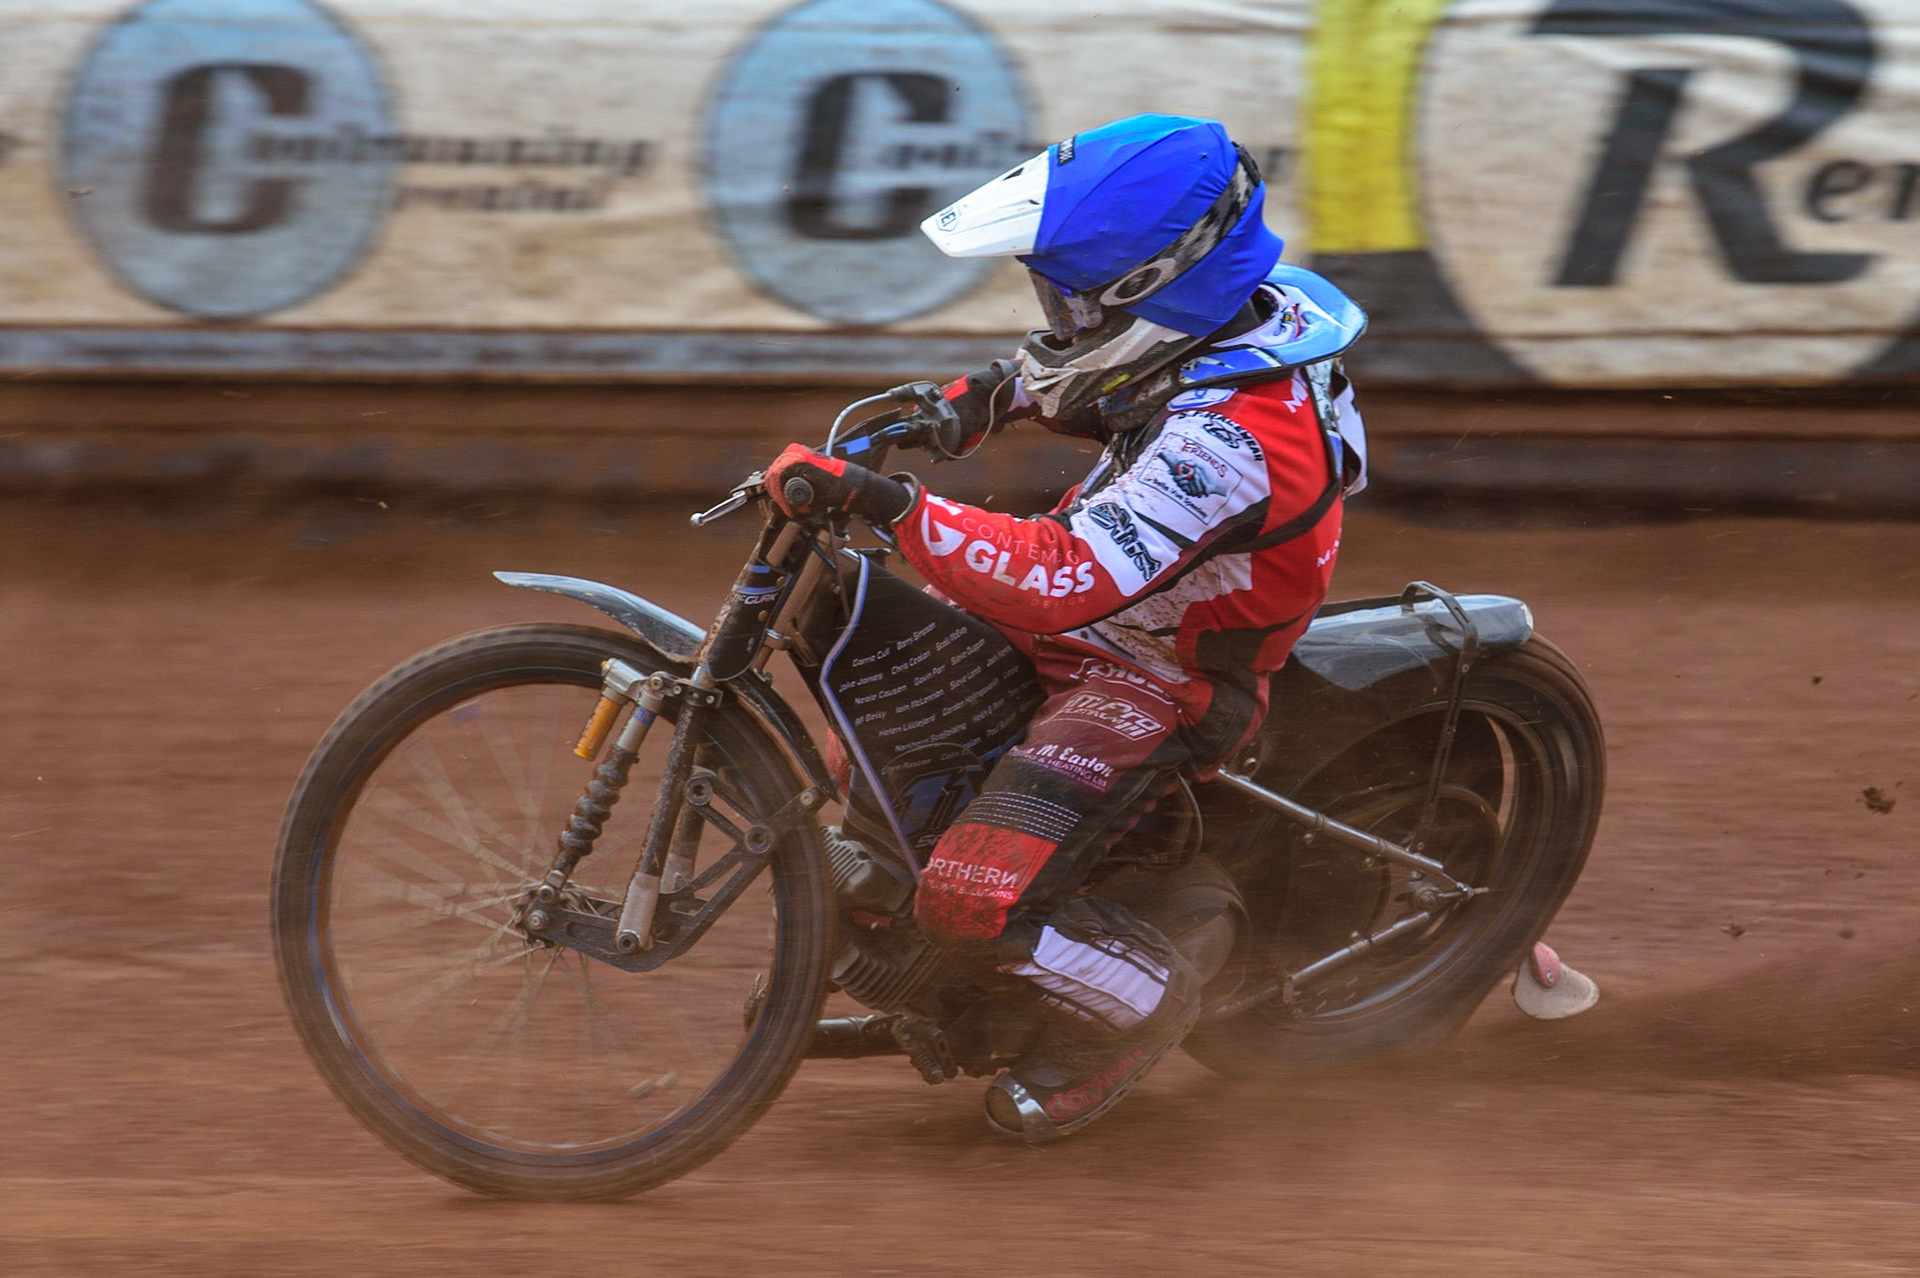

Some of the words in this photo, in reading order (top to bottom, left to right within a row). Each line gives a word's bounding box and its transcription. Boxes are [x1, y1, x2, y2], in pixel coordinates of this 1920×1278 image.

[965, 539, 1095, 598] GLASS
[1048, 759, 1092, 781] HEATING
[1059, 746, 1115, 778] Easton
